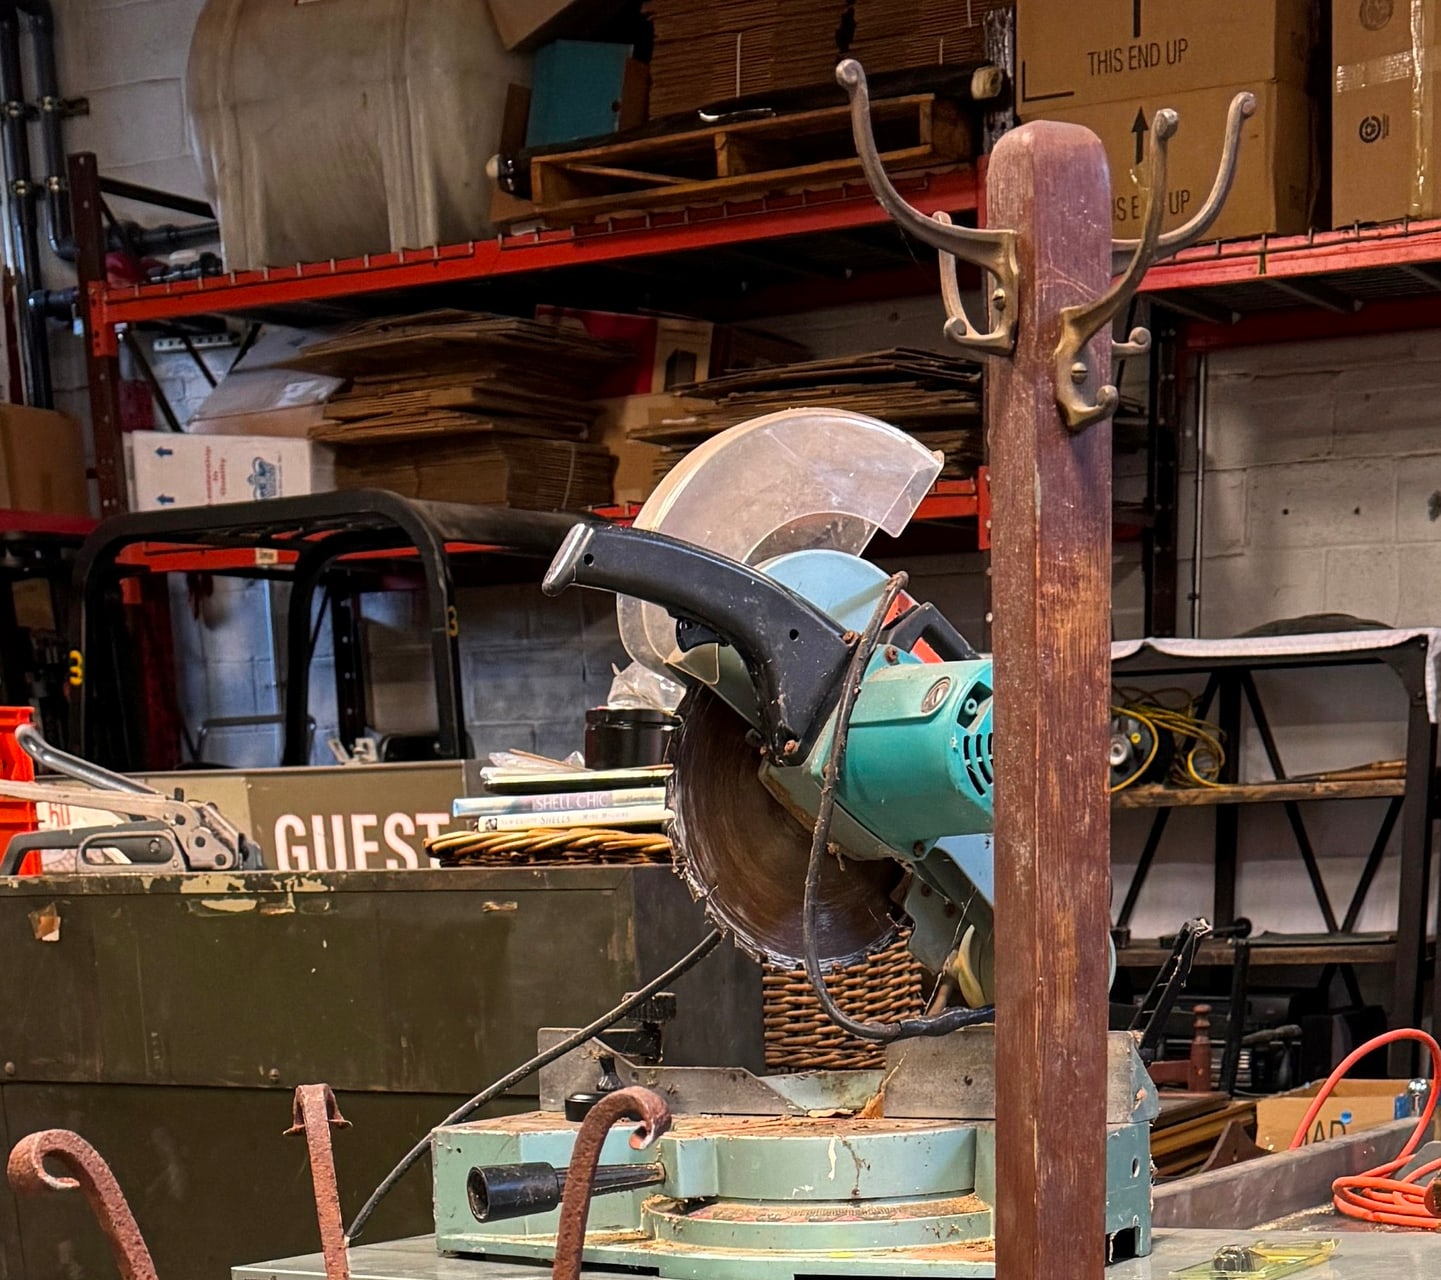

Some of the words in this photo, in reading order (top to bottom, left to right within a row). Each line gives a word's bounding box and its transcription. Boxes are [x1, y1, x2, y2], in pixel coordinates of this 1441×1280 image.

[1087, 47, 1124, 76] THIS
[1128, 42, 1161, 71] END
[1166, 38, 1189, 65] UP
[1168, 189, 1191, 215] UP
[447, 605, 459, 637] 3
[69, 650, 83, 686] 3
[535, 795, 575, 811] SHELL
[577, 793, 609, 809] CHIC
[274, 812, 450, 871] GUEST
